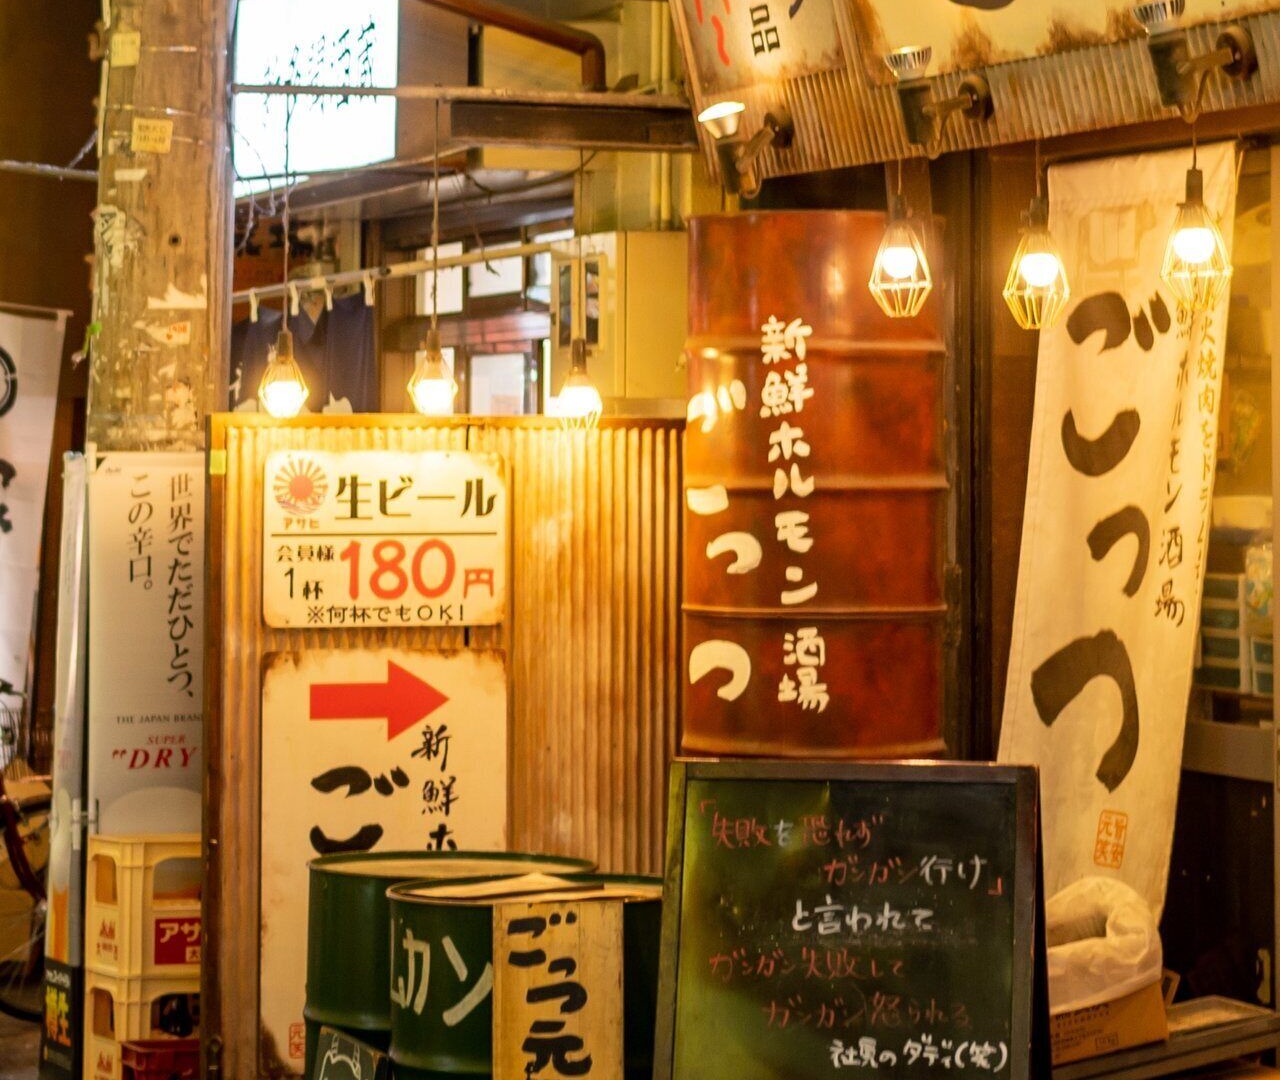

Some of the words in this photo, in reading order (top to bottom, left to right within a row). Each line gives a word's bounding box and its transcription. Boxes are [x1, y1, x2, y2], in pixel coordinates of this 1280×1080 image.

[335, 475, 497, 520] 生ビール
[760, 314, 829, 713] 新鮮ホルモン酒場
[128, 473, 154, 590] この辛口。
[283, 517, 320, 530] アサヒ
[277, 544, 335, 563] 会員様
[339, 539, 495, 601] 180円
[167, 473, 195, 698] 世界でただひとつ、
[284, 567, 324, 600] 1杯
[792, 894, 934, 936] と言われて
